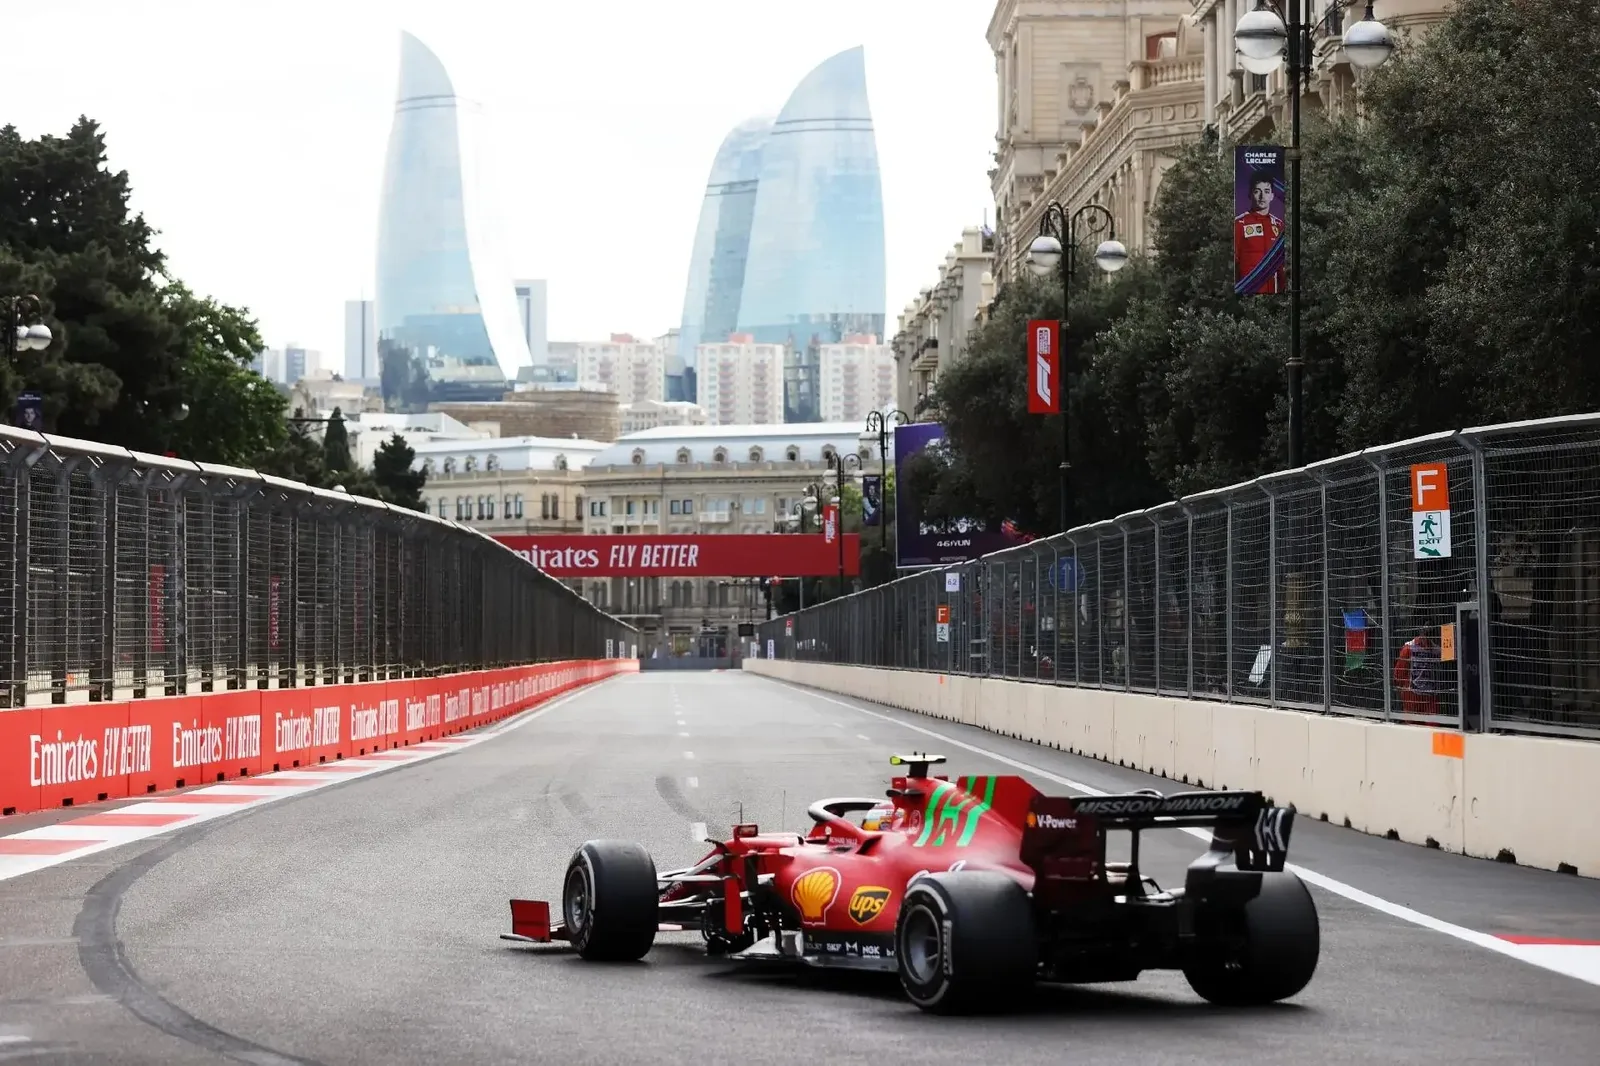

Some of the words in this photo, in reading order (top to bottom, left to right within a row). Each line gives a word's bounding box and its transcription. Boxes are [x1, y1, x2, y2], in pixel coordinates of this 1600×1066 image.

[1417, 470, 1439, 505] F
[609, 545, 637, 568] FLY
[640, 544, 699, 568] BETTER
[938, 608, 946, 622] F
[276, 708, 312, 752] Emirates
[351, 702, 378, 740] Emirates
[172, 718, 222, 768] Emirates
[226, 716, 238, 760] FLY
[238, 714, 260, 760] BETTER
[30, 729, 98, 787] Emirates
[102, 727, 120, 778] FLY
[120, 724, 151, 775] BETTER
[1075, 800, 1160, 813] MISSION
[1037, 814, 1077, 828] V-Power
[851, 894, 884, 918] ups
[862, 946, 880, 955] NGK
